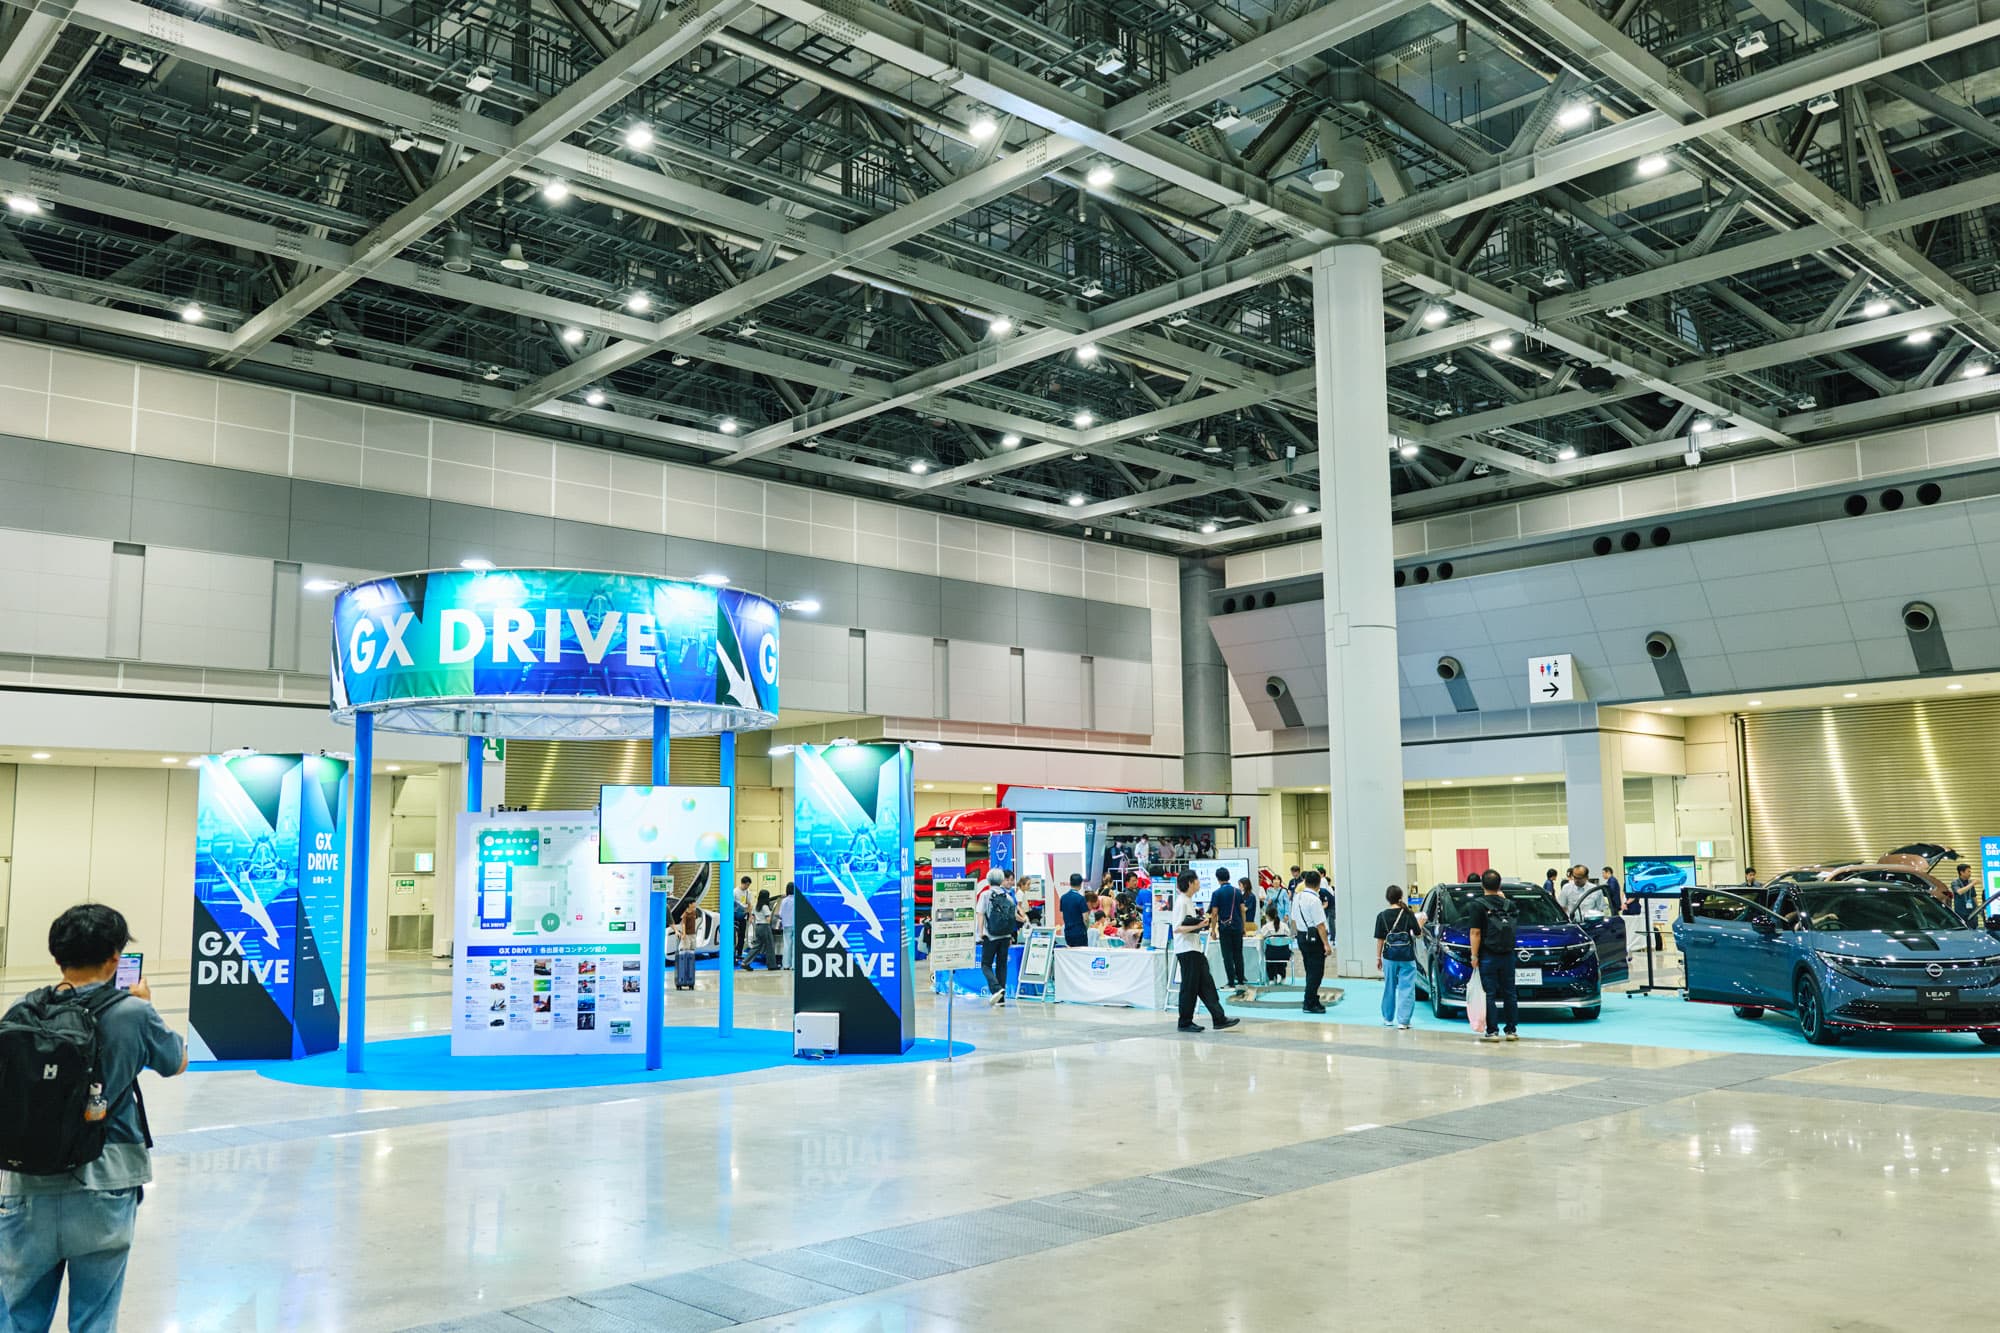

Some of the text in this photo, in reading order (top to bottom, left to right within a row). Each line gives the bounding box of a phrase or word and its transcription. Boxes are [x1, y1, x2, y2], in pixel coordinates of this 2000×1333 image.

[349, 608, 658, 674] GX DRIVE
[1126, 795, 1192, 810] VR防災体験実施中
[315, 831, 332, 851] GX
[307, 852, 339, 871] DRIVE
[198, 931, 248, 956] GX
[802, 923, 850, 950] GX
[197, 960, 289, 985] DRIVE
[801, 952, 895, 978] DRIVE
